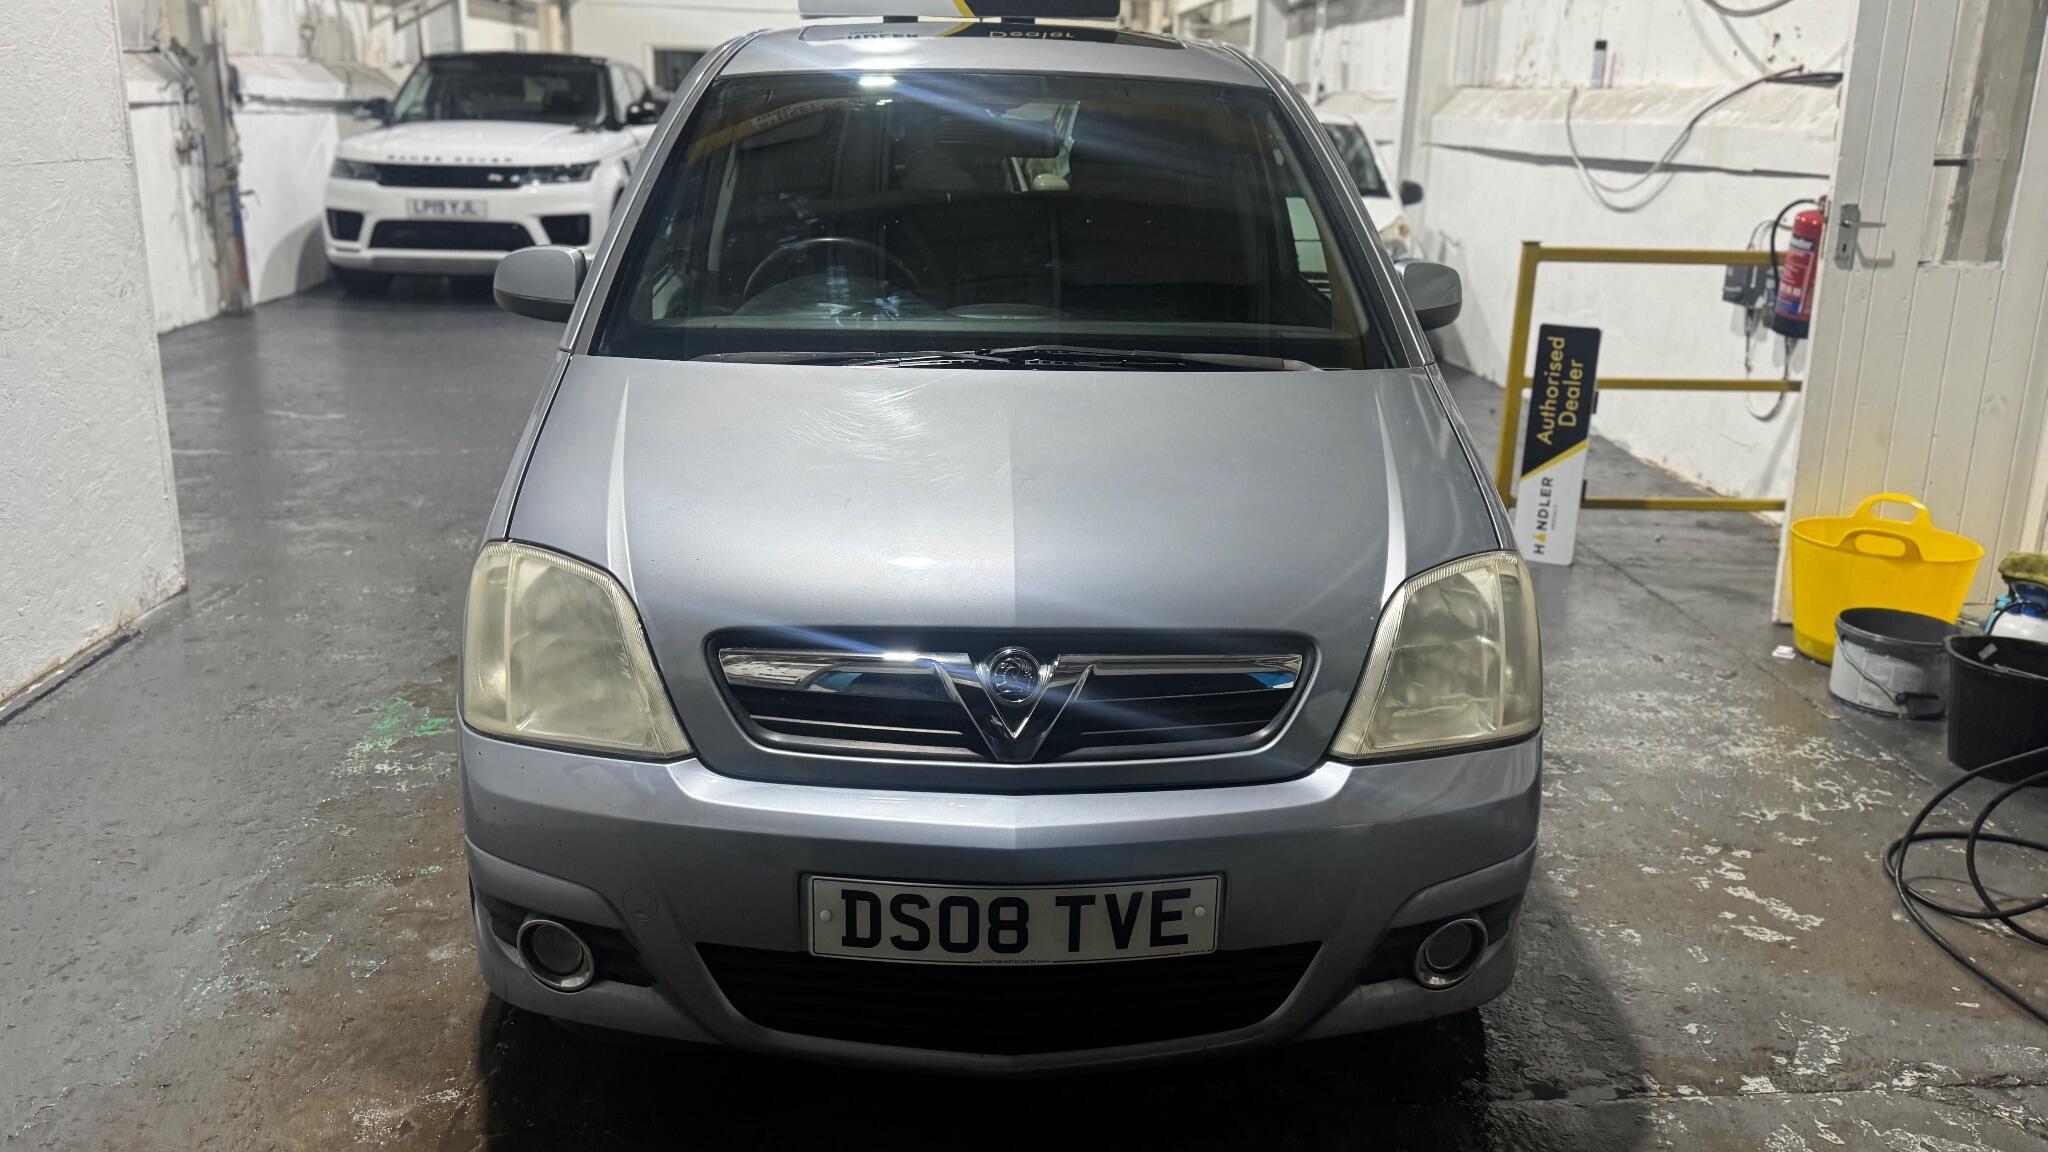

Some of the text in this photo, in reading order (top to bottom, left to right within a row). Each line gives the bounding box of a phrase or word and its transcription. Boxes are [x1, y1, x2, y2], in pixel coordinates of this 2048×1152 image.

[1536, 336, 1566, 446] Authorised
[1557, 359, 1584, 428] Dealer
[841, 887, 1191, 954] DS08 TVE
